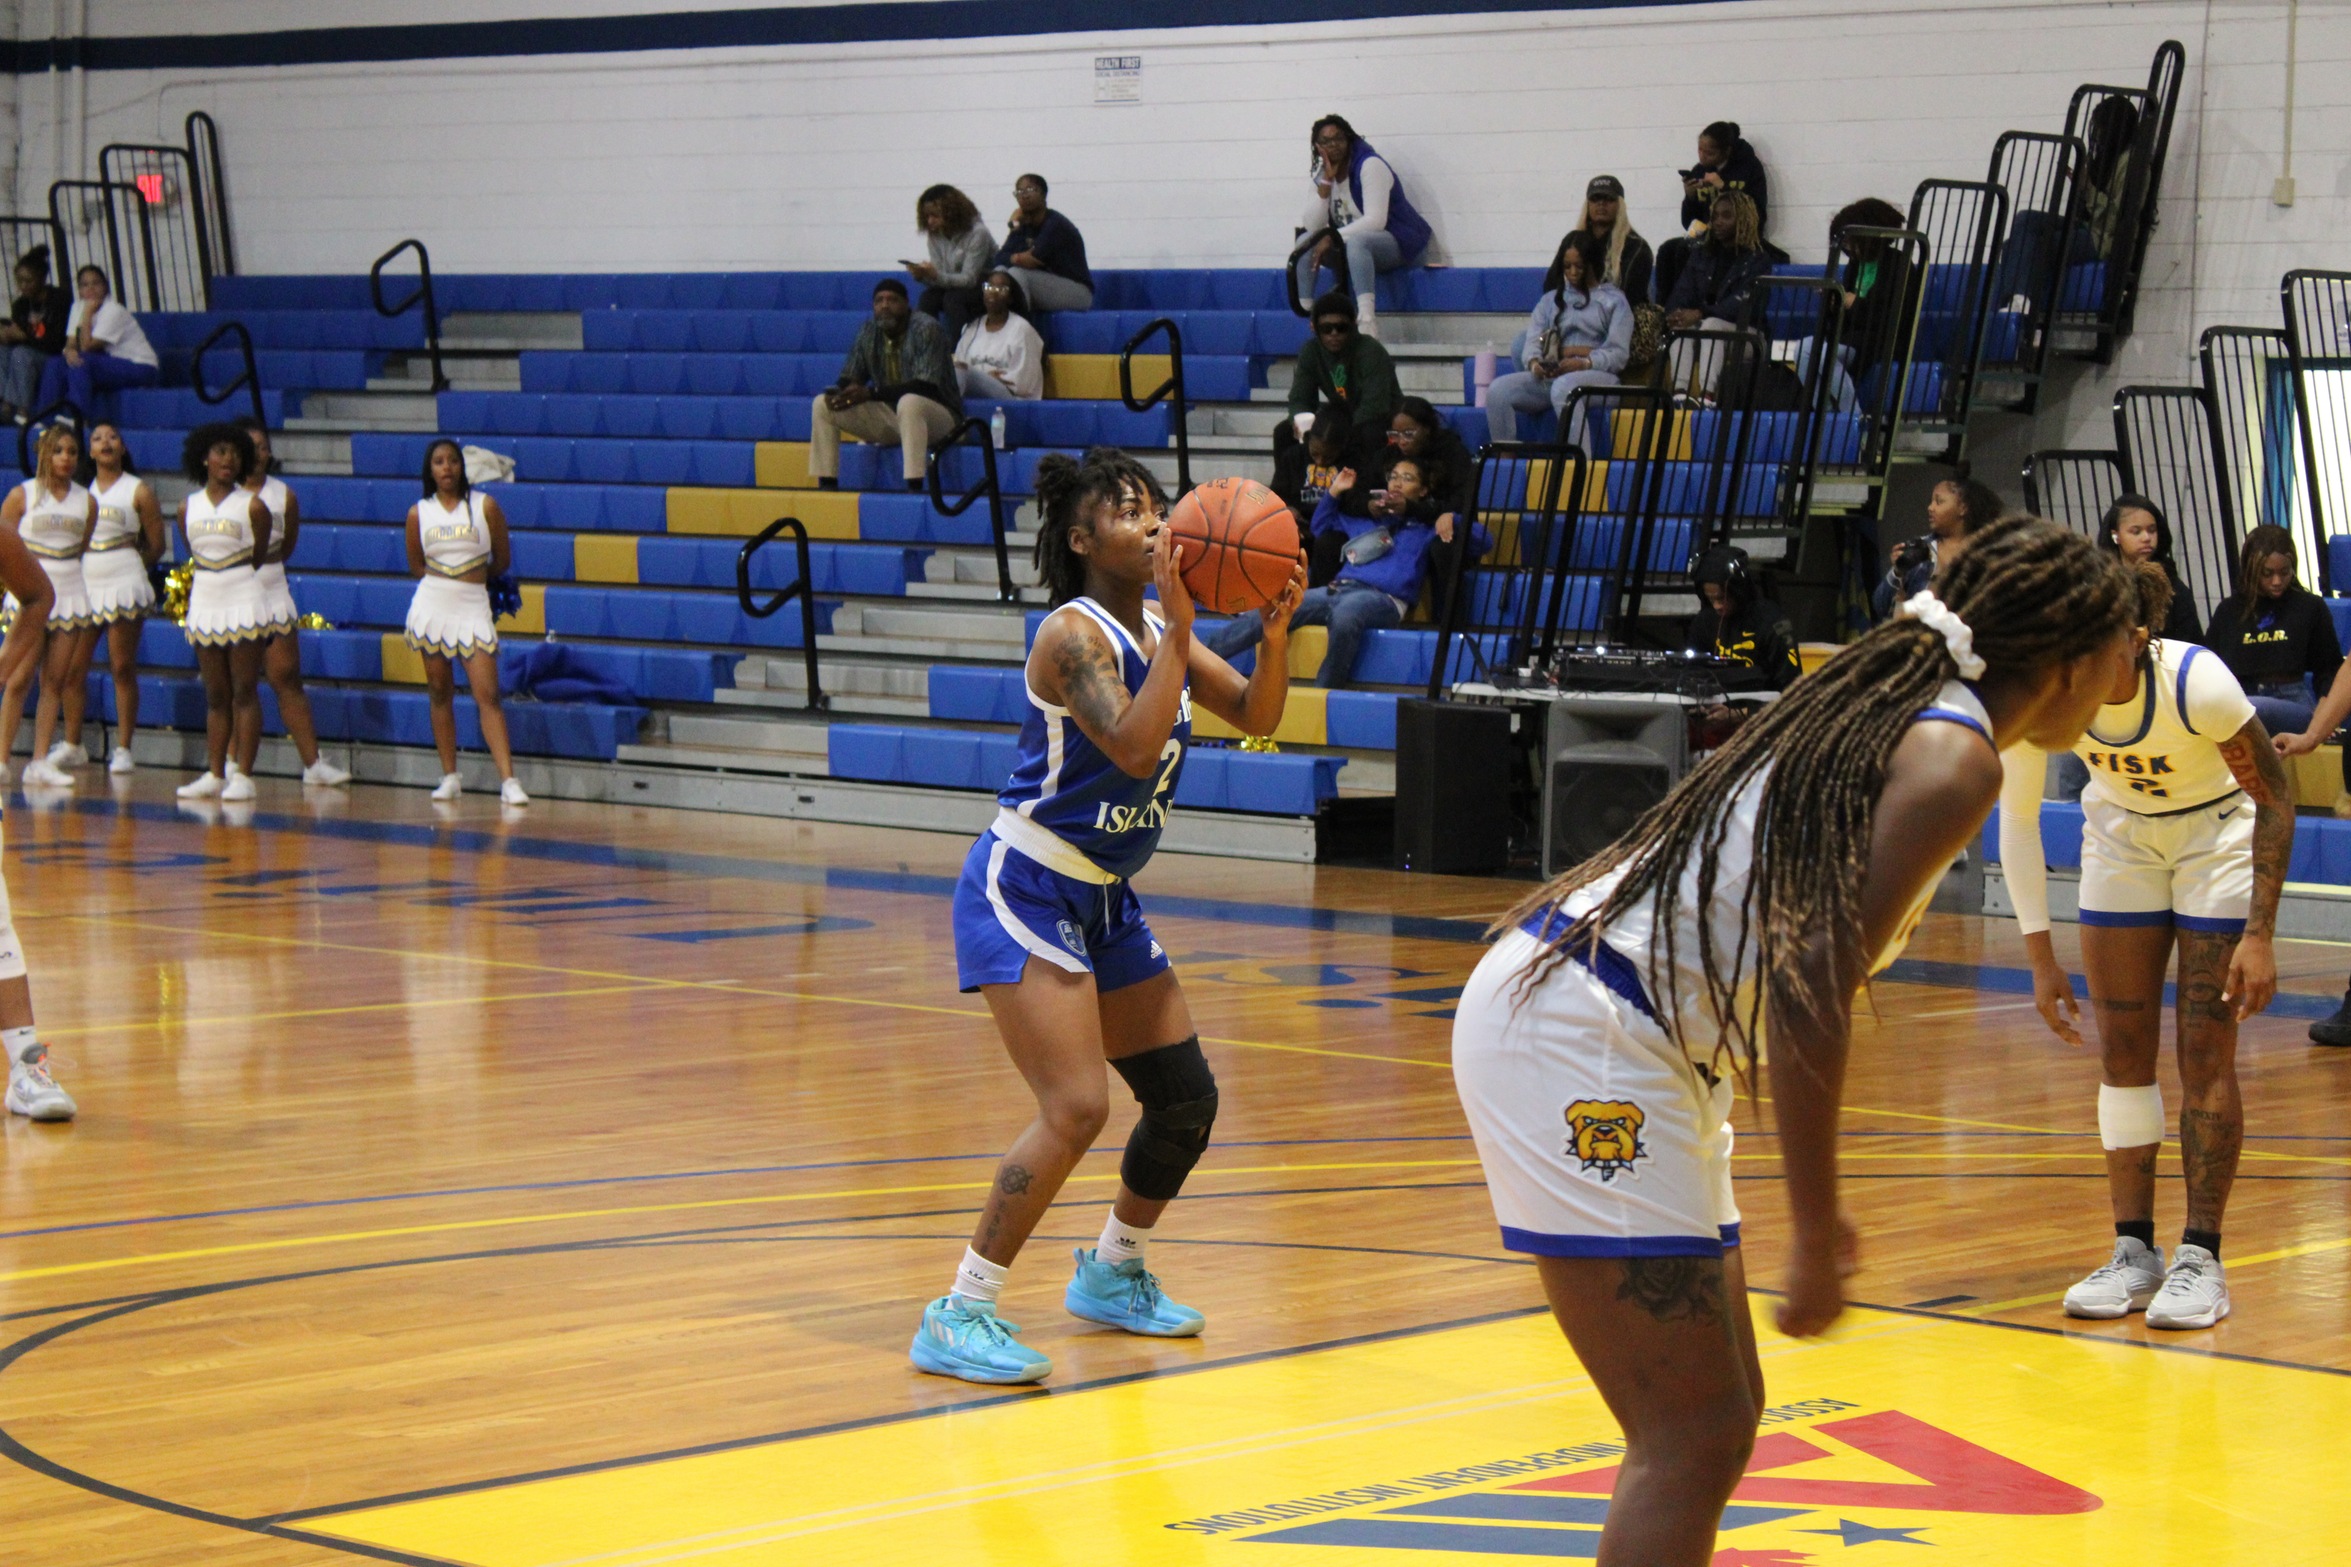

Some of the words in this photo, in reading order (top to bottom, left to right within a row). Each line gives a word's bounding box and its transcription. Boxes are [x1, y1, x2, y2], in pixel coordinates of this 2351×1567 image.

[1152, 738, 1182, 797] 2
[2088, 752, 2175, 775] FISK
[1093, 798, 1175, 833] ISLAN
[1410, 1441, 1628, 1490] INDEPENDENT
[1163, 1479, 1425, 1535] INSTITUTIONS
